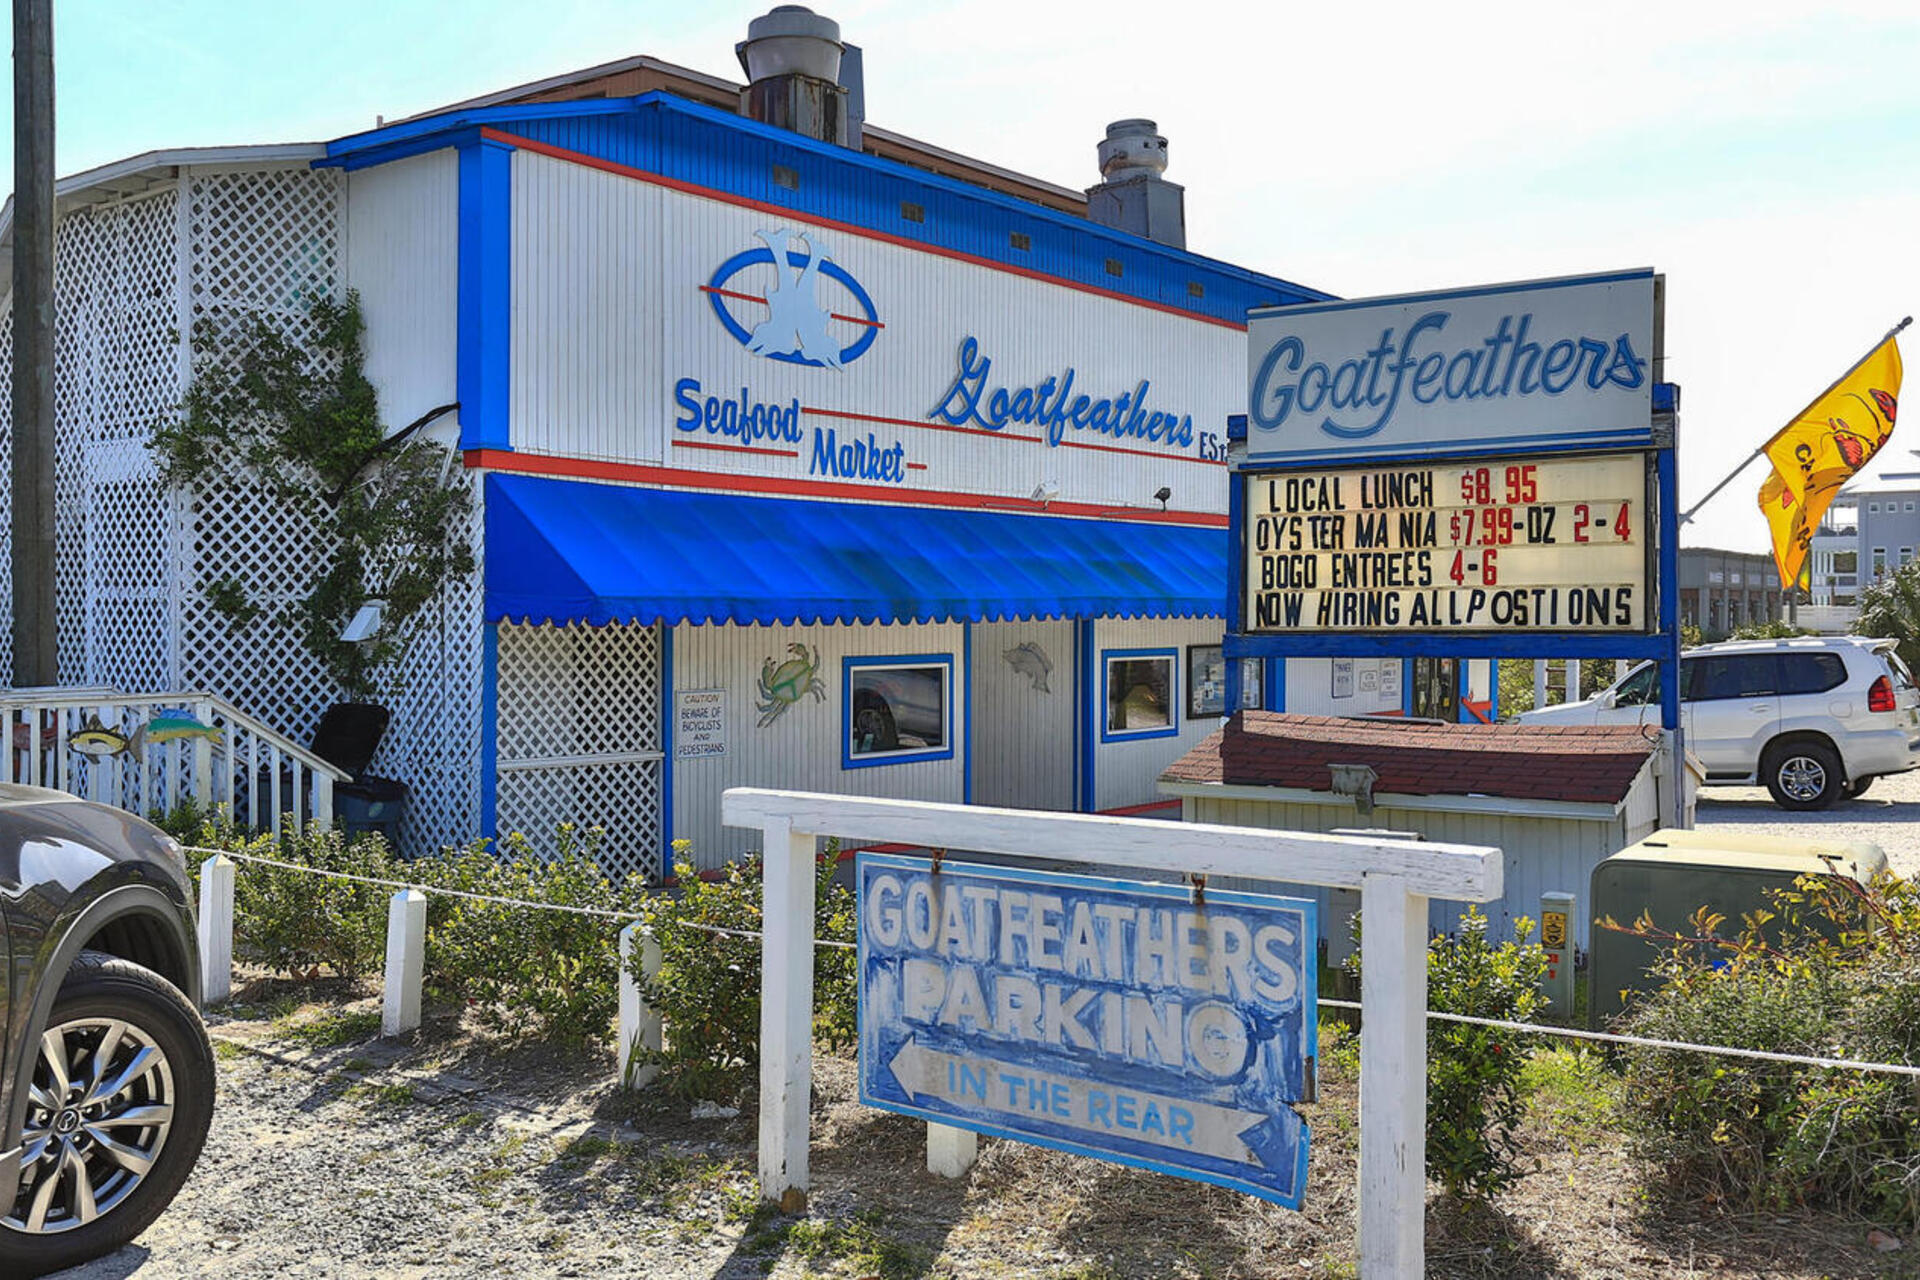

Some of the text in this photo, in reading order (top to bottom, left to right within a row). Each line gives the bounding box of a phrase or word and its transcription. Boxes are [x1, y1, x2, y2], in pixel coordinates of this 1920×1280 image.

[926, 336, 1195, 448] Goatfeathers
[1251, 311, 1646, 440] Goatfeathers
[674, 377, 803, 446] Seafood
[810, 427, 905, 484] Market
[1269, 465, 1538, 513] LOCAL LUNCH $8.95
[1256, 515, 1346, 551] OYSTER
[1262, 549, 1497, 590] BOGO ENTREES 4-6
[1256, 592, 1304, 628] NOW
[1316, 590, 1400, 627] HIRING
[1409, 589, 1462, 626] ALL
[868, 875, 1298, 1003] GOATFEATHERS
[947, 1060, 1195, 1145] IN THE REAR
